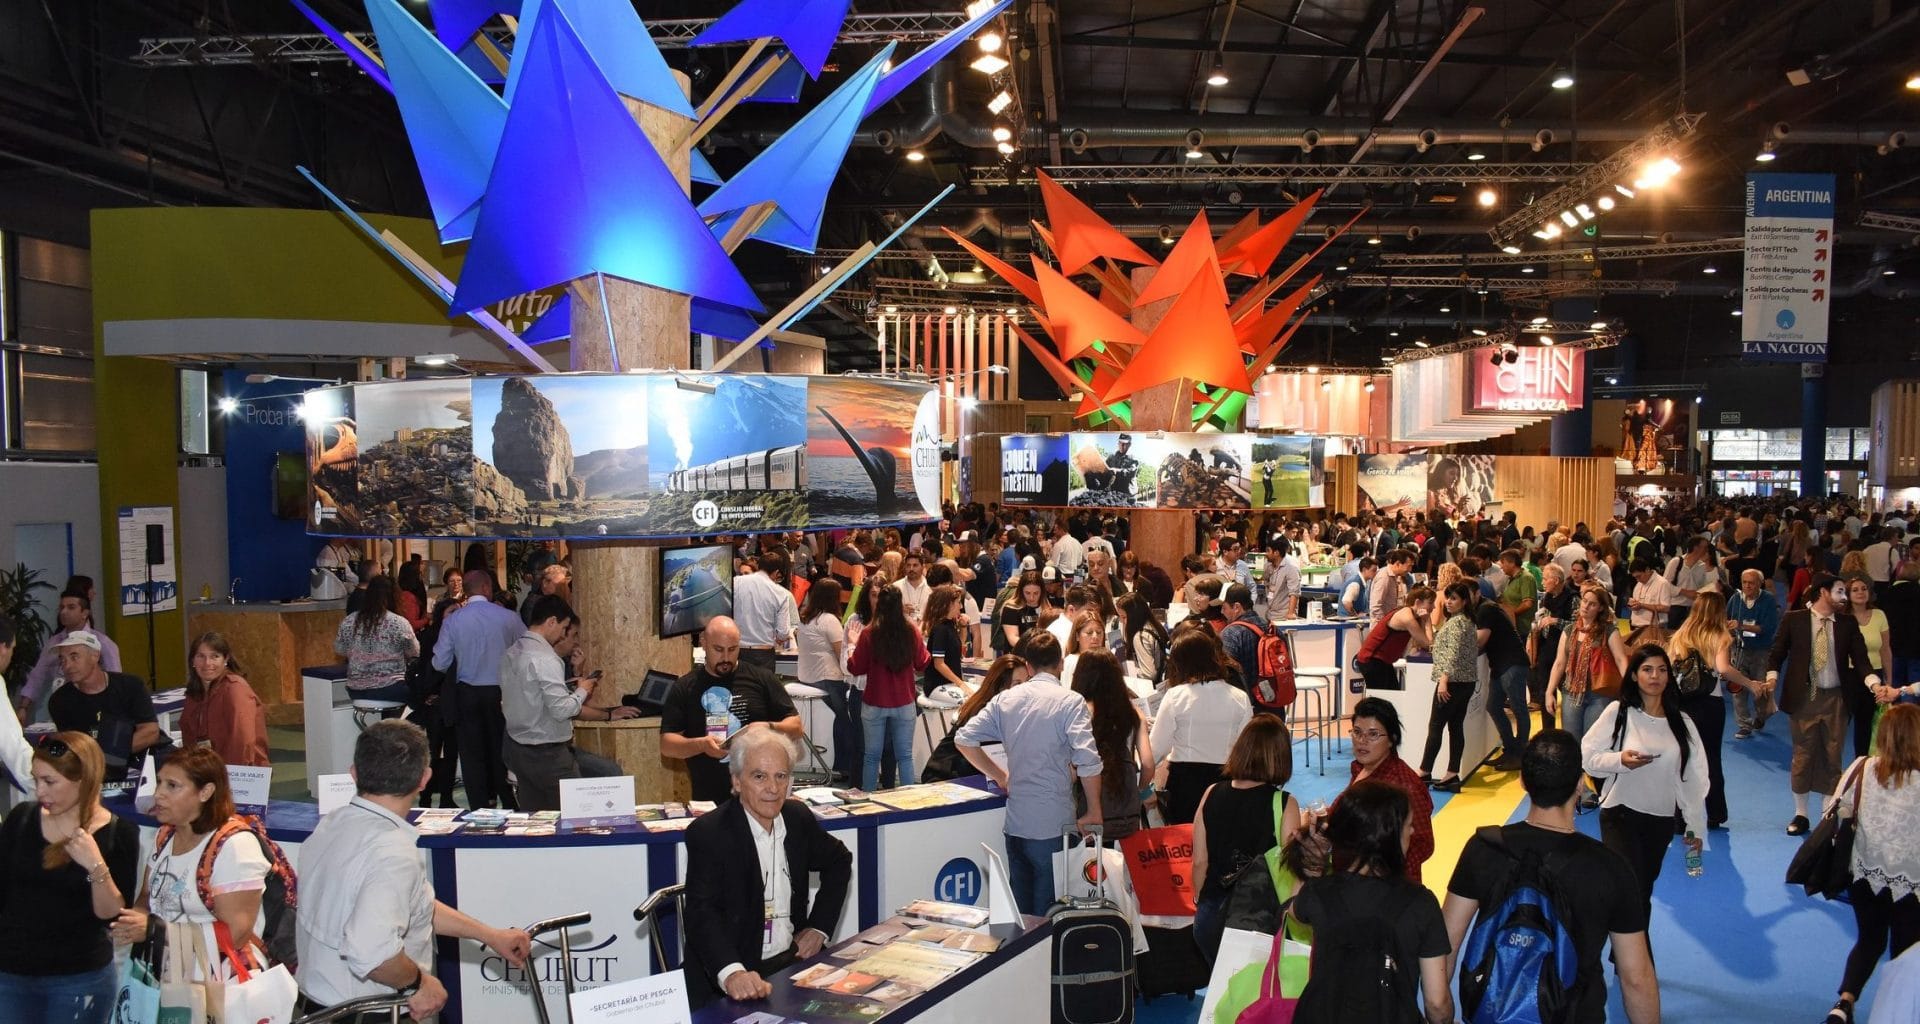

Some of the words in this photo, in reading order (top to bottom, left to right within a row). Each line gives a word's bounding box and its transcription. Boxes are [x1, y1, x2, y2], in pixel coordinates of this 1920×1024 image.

[1746, 181, 1755, 217] AVENIDA
[1765, 190, 1831, 203] ARGENTINA
[1782, 267, 1811, 275] Negocios
[1743, 343, 1762, 353] LA
[1768, 343, 1826, 355] NACION
[1499, 399, 1568, 411] MENDOZA
[246, 404, 282, 425] Proba
[1010, 473, 1042, 493] DESTINO
[695, 507, 715, 520] CFI
[940, 871, 974, 902] CFI
[639, 993, 648, 1001] DE
